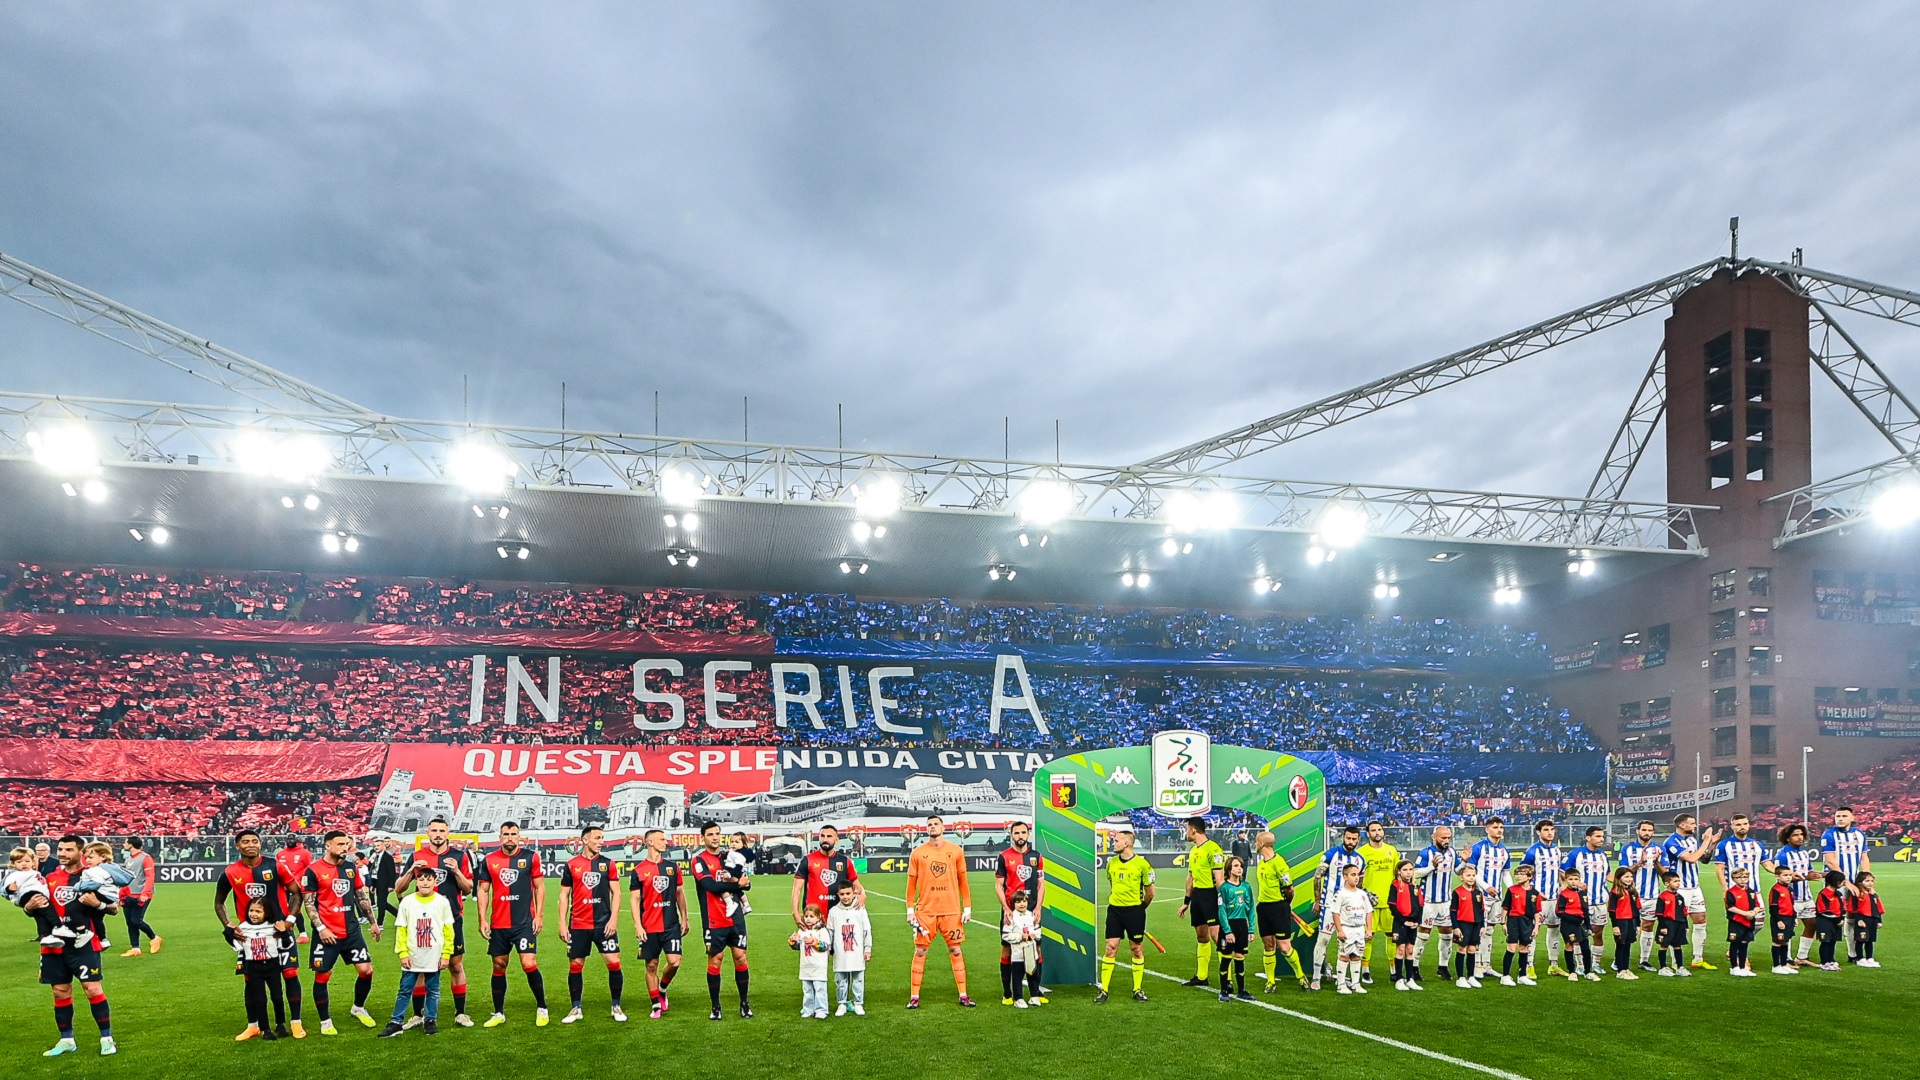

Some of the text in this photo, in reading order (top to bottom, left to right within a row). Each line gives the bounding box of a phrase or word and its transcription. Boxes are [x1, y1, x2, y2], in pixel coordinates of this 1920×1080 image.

[469, 654, 1051, 735] IN SERIE A
[1827, 707, 1867, 719] MERANO
[463, 749, 1054, 777] QUESTA SPLENDIDA CITTA'
[1169, 777, 1194, 787] Serie
[1160, 790, 1204, 806] BKT
[1629, 792, 1695, 805] GIUSTIZIA PER
[1698, 787, 1729, 801] 24/25
[1533, 799, 1556, 807] ISOLA
[1574, 803, 1616, 816] ZOAGLI
[1647, 800, 1696, 812] SCUDETTO
[673, 834, 697, 846] FIGGI
[932, 865, 944, 873] 105
[1367, 859, 1393, 867] Casillo
[161, 867, 214, 882] SPORT
[584, 876, 598, 884] 105
[56, 890, 74, 900] 105
[247, 888, 264, 896] 105
[417, 918, 432, 930] ONLY
[417, 932, 432, 948] ONE
[737, 934, 747, 947] 14
[949, 929, 962, 941] 22
[519, 937, 527, 950] 8
[670, 939, 680, 952] 11
[351, 947, 367, 961] 24
[79, 964, 89, 979] 2
